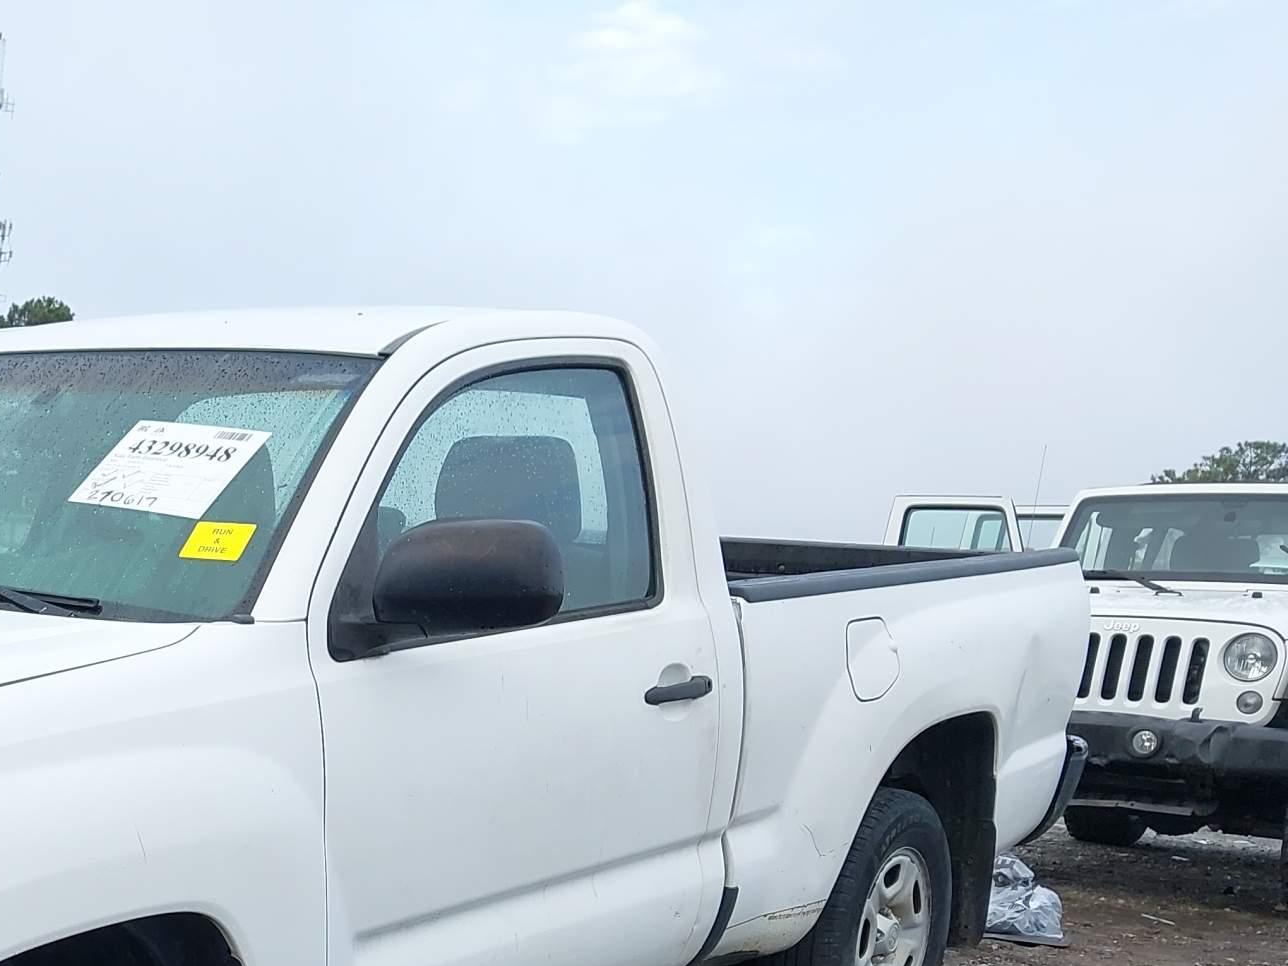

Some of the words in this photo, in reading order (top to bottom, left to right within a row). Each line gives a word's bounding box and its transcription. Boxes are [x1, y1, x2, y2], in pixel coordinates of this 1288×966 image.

[128, 438, 237, 462] 43298948
[197, 545, 228, 554] DRIVE
[1103, 619, 1140, 633] Jeep
